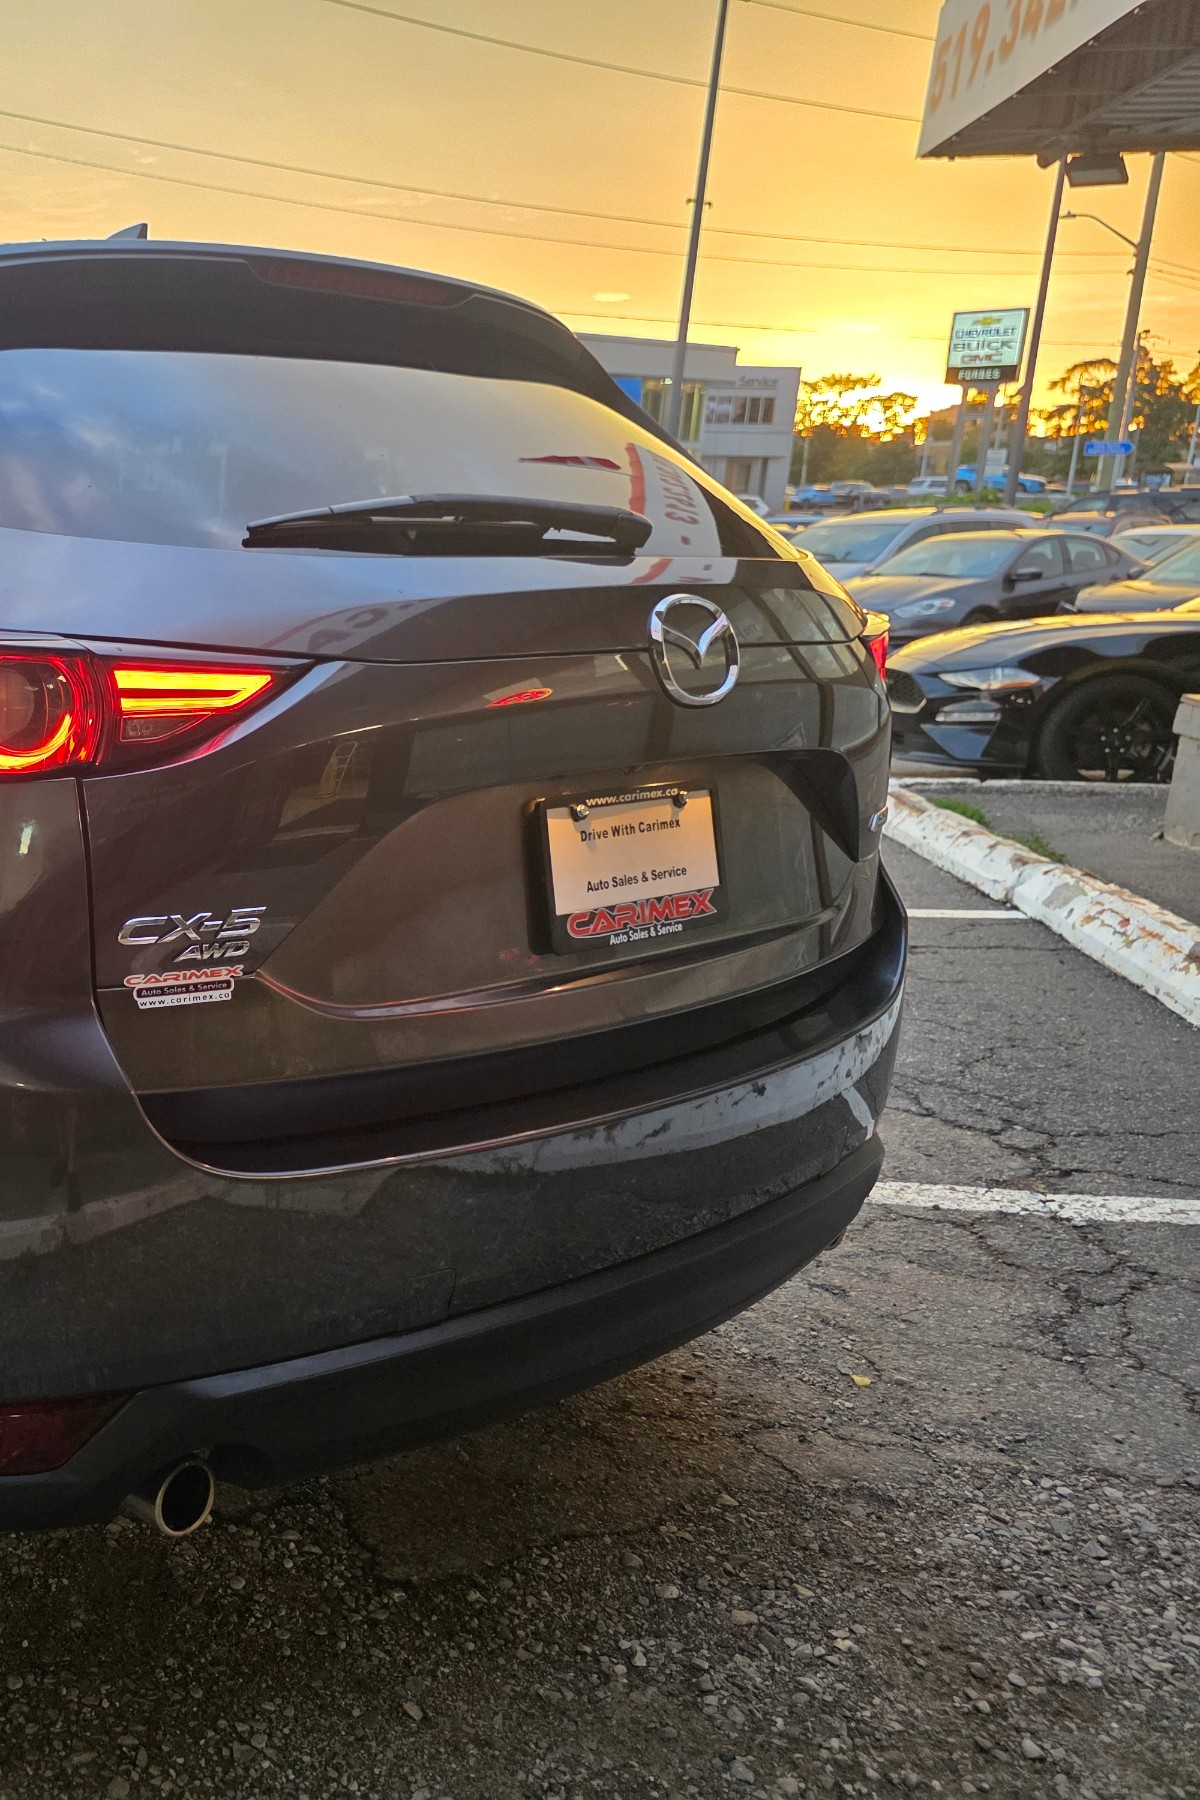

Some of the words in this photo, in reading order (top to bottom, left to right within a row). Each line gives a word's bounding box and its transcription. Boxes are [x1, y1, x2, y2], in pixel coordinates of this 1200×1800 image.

[955, 325, 1017, 339] CHEVROLET
[953, 339, 1015, 353] BUICK
[961, 353, 1003, 364] GMC
[585, 787, 679, 807] www.carimex.ca
[580, 829, 609, 843] Drive
[611, 823, 636, 838] With
[638, 818, 681, 834] Carimex
[586, 880, 610, 893] Auto
[611, 873, 639, 888] Sales
[641, 871, 649, 882] &
[651, 866, 687, 881] Service
[567, 888, 717, 938] CARIMEX
[118, 906, 267, 946] CX-5
[609, 934, 628, 946] Auto
[629, 930, 649, 942] Sales
[650, 927, 657, 937] &
[658, 922, 683, 937] Service
[173, 940, 250, 962] AWD
[125, 966, 243, 986] CARIMEX
[139, 991, 230, 1007] www.carimex.ca
[141, 988, 162, 997] Auto
[164, 985, 187, 995] Sales
[188, 984, 195, 992] &
[197, 981, 228, 991] Service
